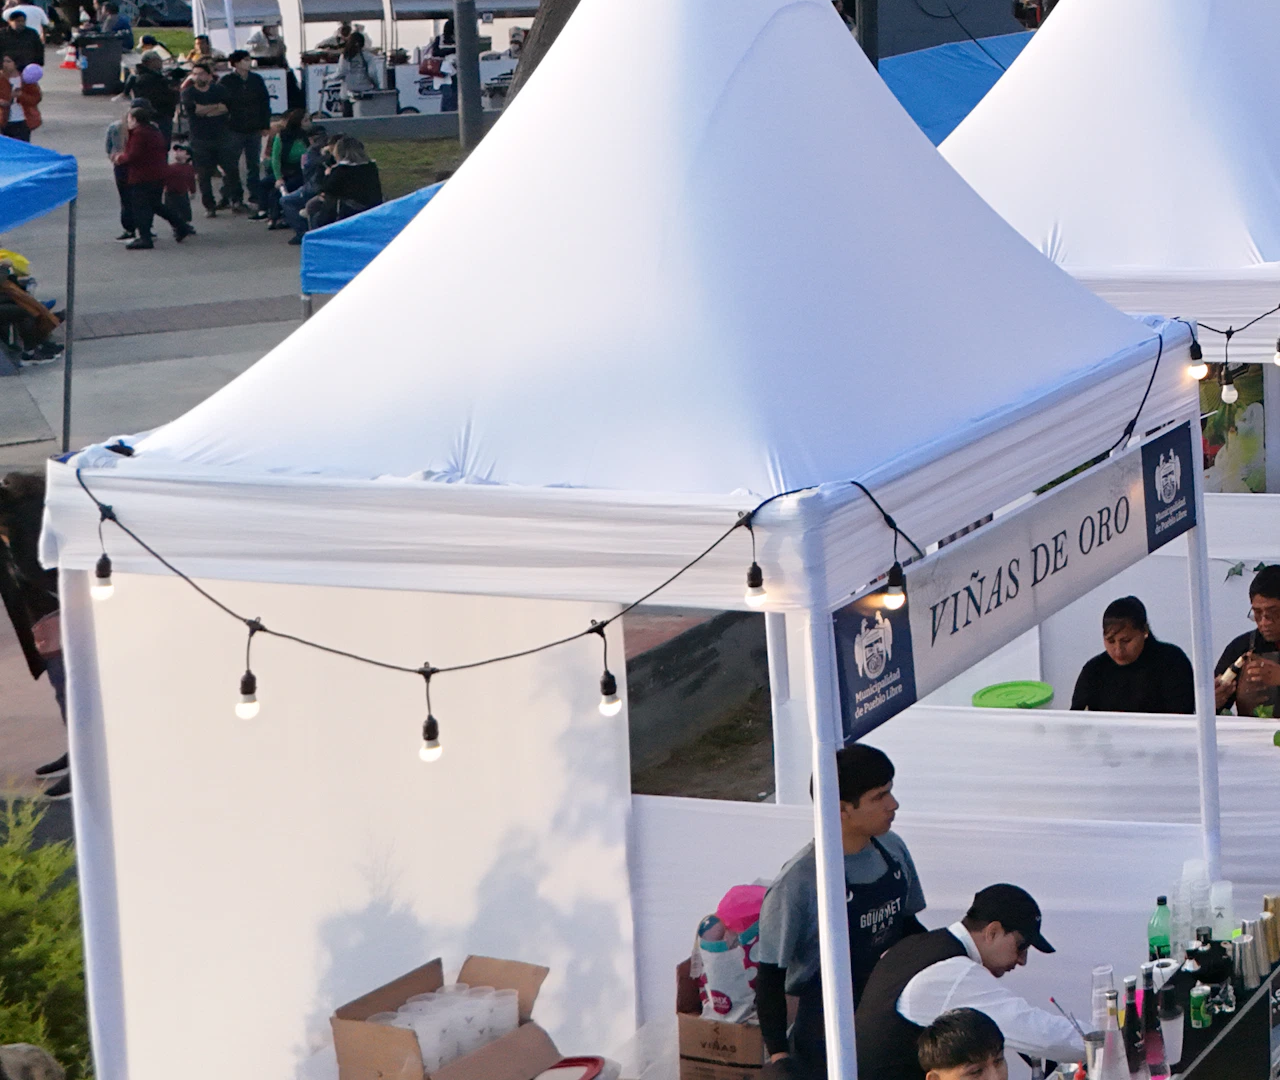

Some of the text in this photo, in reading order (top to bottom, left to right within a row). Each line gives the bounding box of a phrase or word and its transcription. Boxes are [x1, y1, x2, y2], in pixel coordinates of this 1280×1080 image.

[929, 496, 1130, 648] VIÑAS DE ORO
[854, 683, 903, 719] de Pueblo Libre
[855, 668, 900, 704] Municipalidad
[860, 897, 901, 928] GOURMET
[872, 916, 893, 933] BAR
[700, 1041, 736, 1053] VIÑAS
